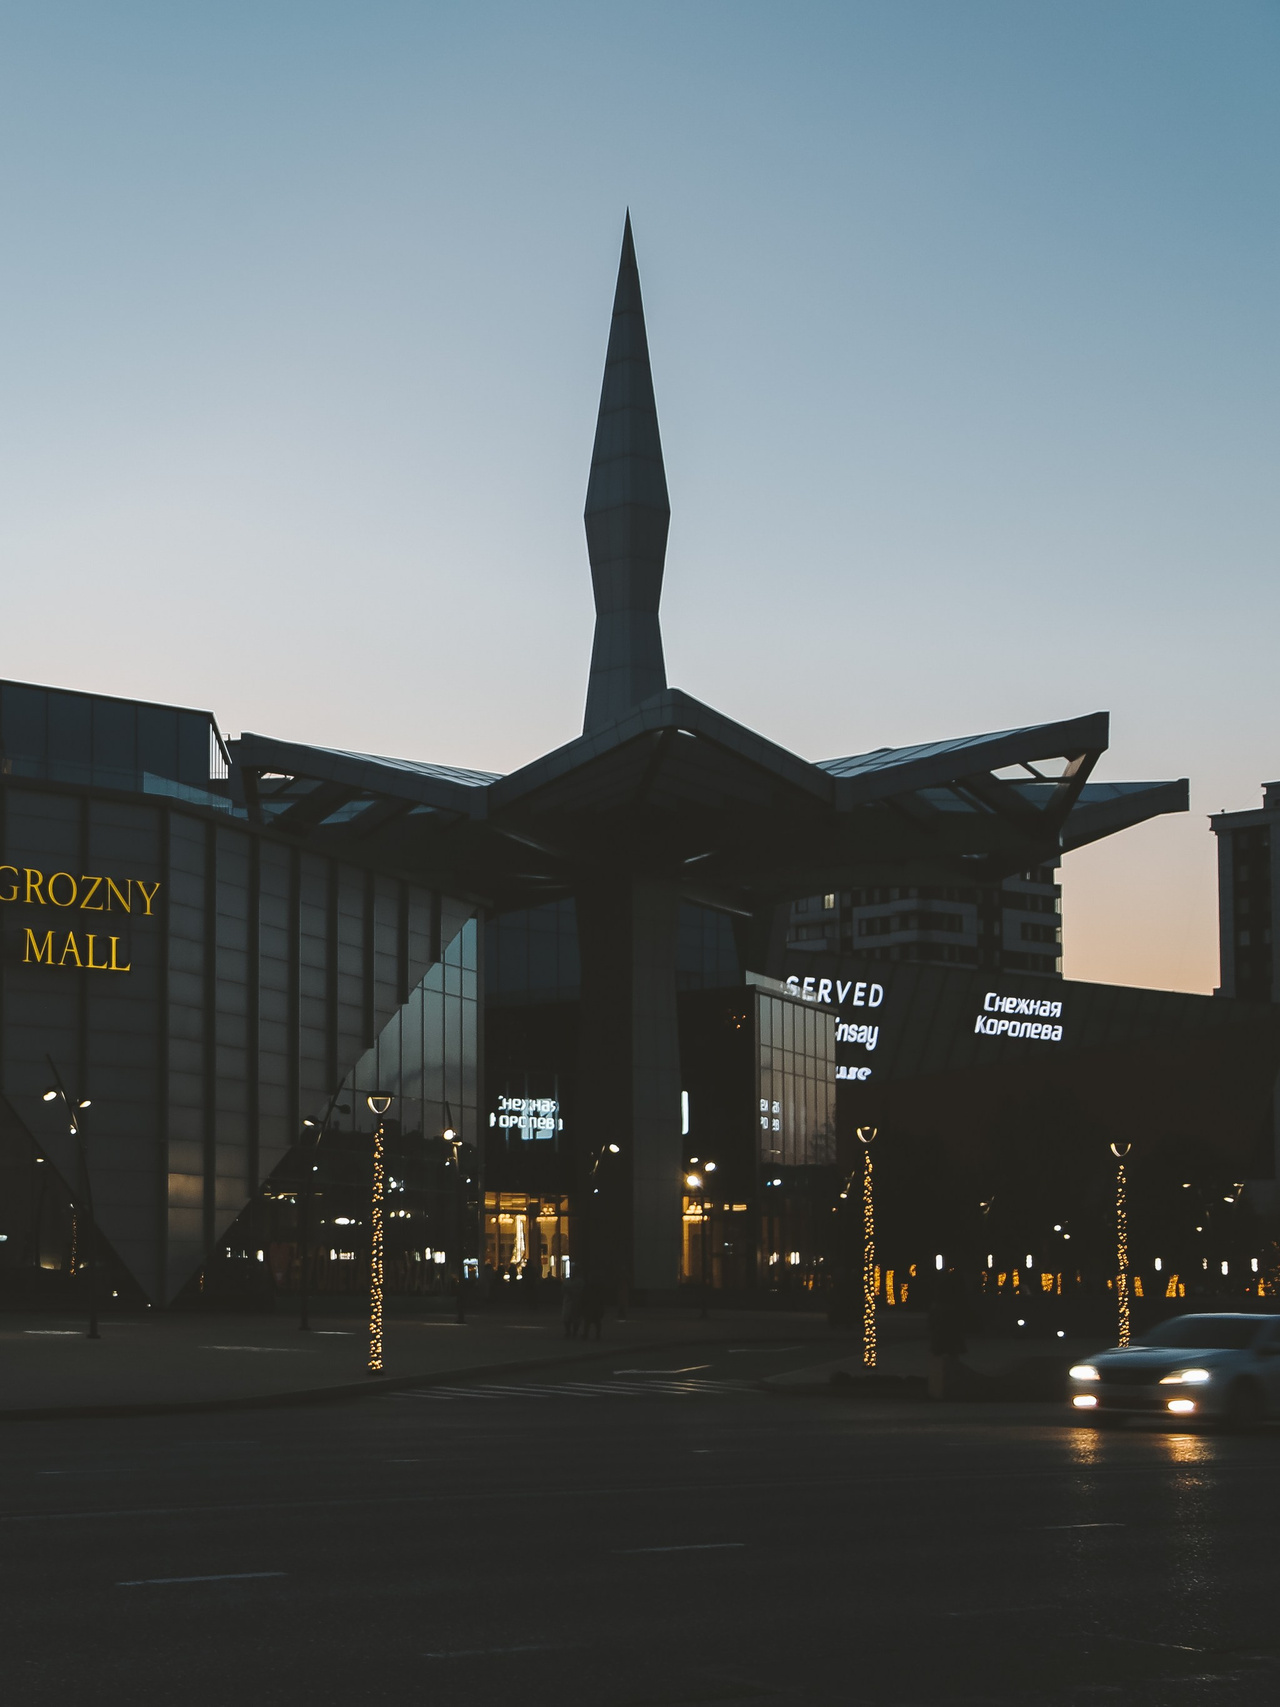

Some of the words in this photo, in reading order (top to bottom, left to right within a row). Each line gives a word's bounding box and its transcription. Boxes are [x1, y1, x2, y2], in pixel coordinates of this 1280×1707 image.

[22, 927, 131, 972] MALL
[983, 992, 1063, 1018] Снежная
[974, 1014, 1063, 1042] Королева
